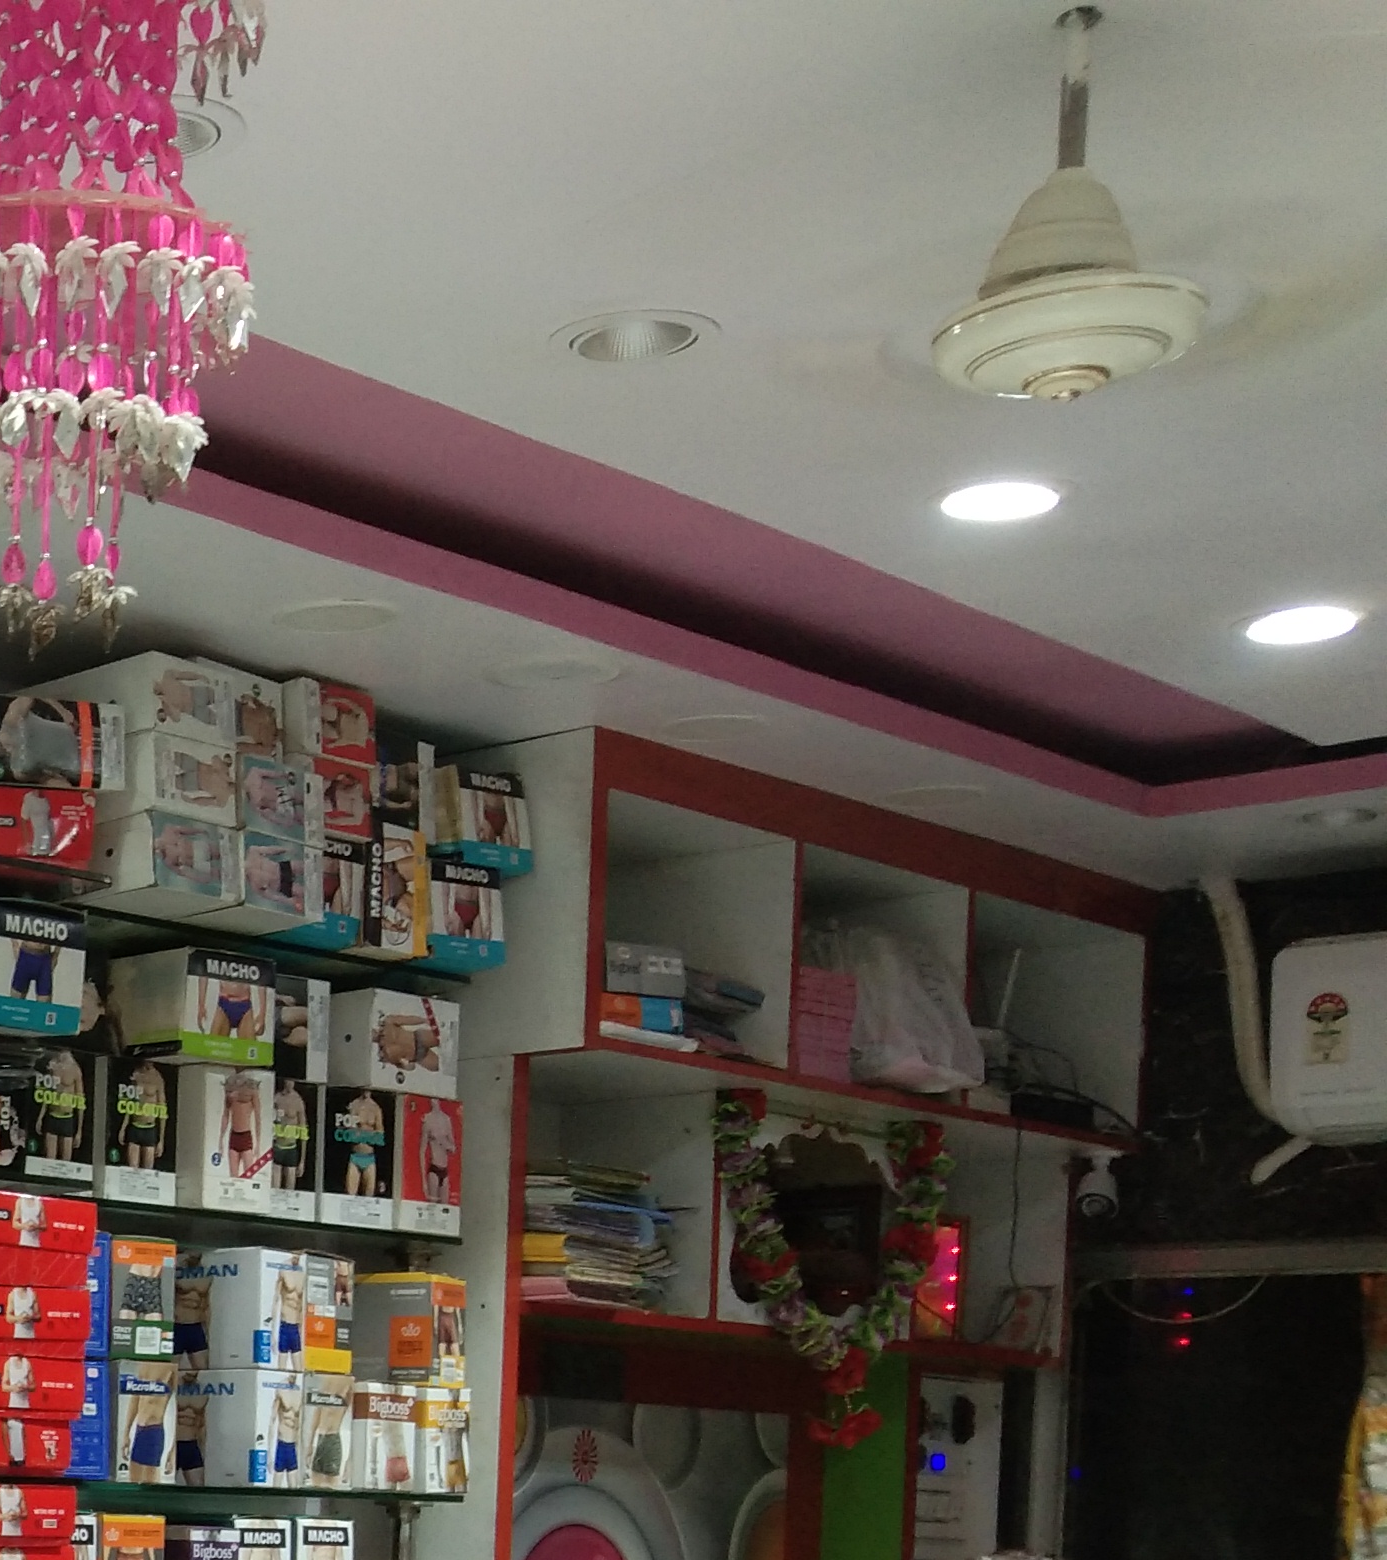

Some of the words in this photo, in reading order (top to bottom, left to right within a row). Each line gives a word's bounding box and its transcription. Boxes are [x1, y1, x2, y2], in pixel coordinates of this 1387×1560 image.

[371, 843, 382, 918] MACHO
[6, 914, 68, 941] MACHO
[117, 1100, 168, 1119] COLOUR
[369, 1396, 408, 1418] Bigboss
[244, 1532, 281, 1544] MACHO
[308, 1530, 344, 1542] MACHO
